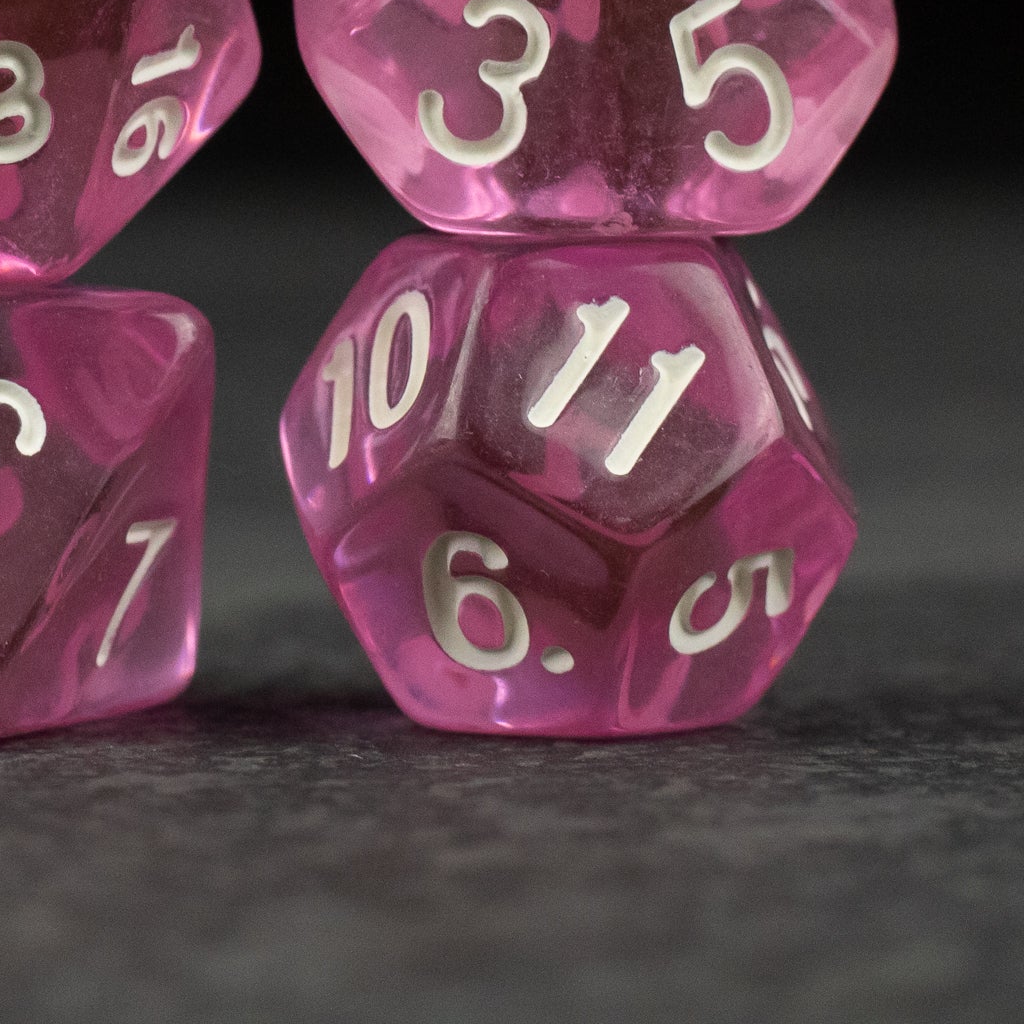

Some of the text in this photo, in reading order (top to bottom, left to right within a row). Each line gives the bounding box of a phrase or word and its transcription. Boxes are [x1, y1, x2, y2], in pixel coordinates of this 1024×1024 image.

[322, 289, 430, 469] 10
[527, 296, 705, 475] 11
[95, 519, 176, 667] 7
[668, 548, 794, 655] 5
